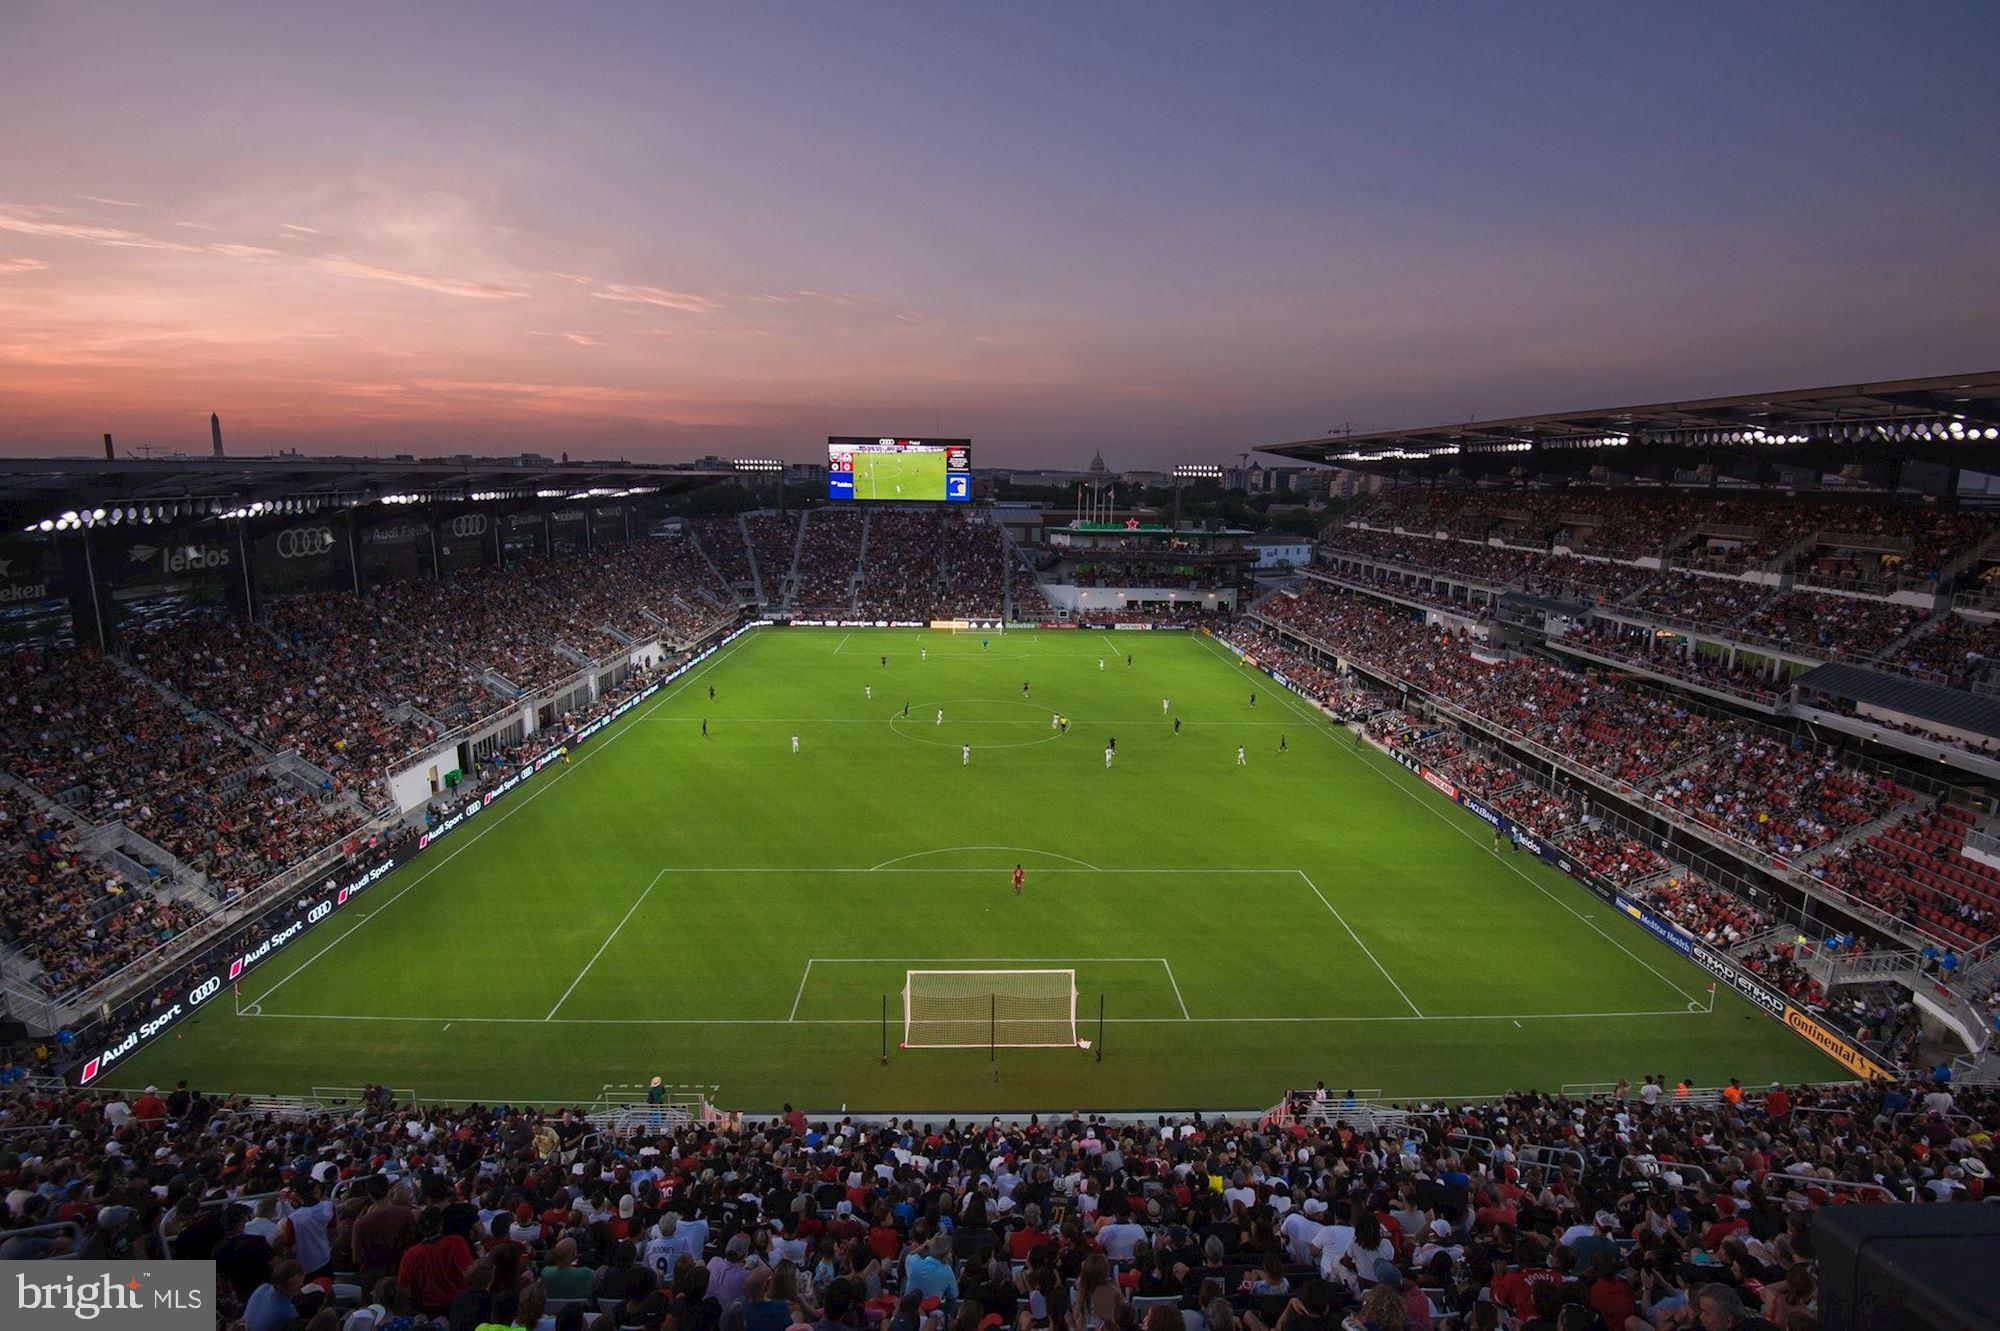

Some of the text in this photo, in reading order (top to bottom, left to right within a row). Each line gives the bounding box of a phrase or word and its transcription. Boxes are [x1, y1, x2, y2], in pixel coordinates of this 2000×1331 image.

[428, 813, 464, 841] Audi Sport
[349, 859, 394, 895] Audi Sport
[243, 920, 303, 967] Audi Sport
[1666, 931, 1690, 953] Health
[1693, 947, 1734, 979] ETIHAD
[1738, 977, 1784, 1011] ETIHAD
[101, 1004, 182, 1066] Audi Sport
[1789, 1012, 1855, 1065] Continental
[656, 1257, 668, 1274] 9
